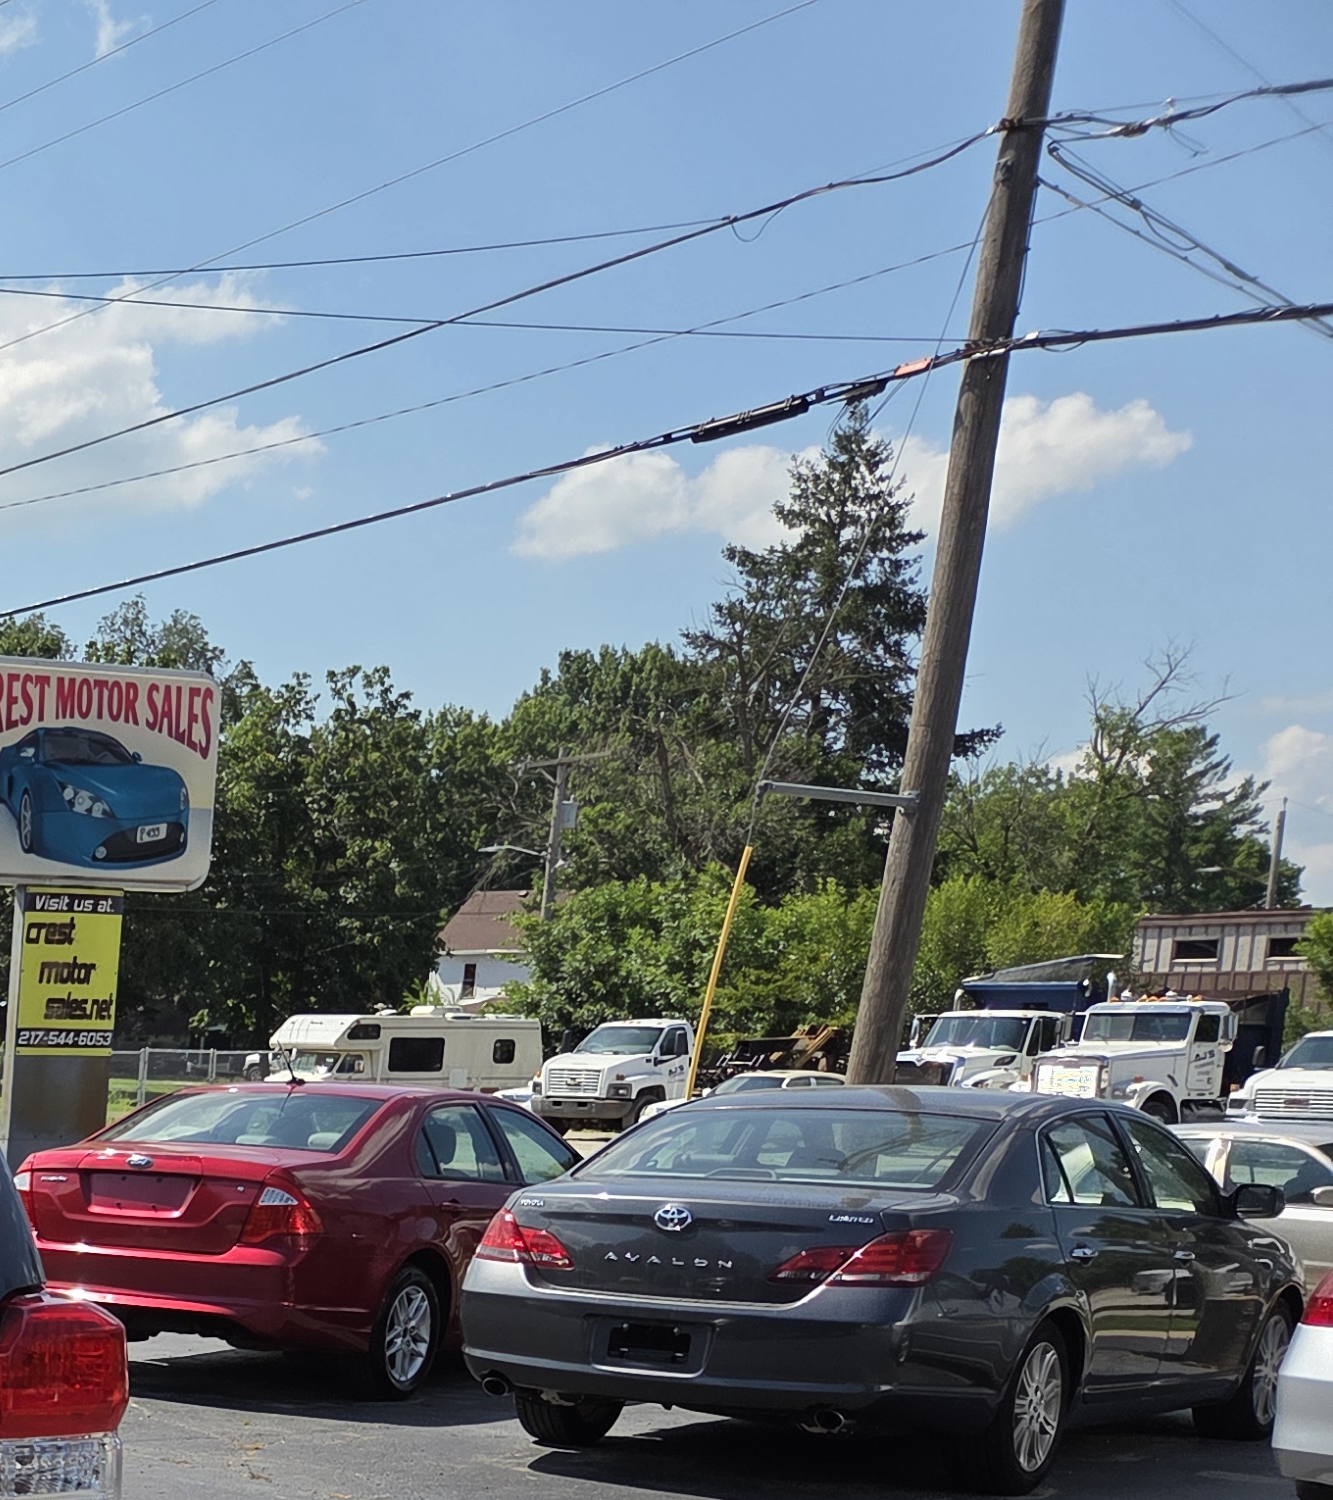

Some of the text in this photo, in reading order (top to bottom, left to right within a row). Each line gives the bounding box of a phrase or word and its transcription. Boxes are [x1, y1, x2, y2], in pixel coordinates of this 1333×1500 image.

[55, 675, 140, 727] MOTOR
[145, 682, 214, 760] SALES
[35, 895, 70, 911] Visit
[73, 899, 94, 912] us
[25, 916, 76, 945] crest
[38, 955, 97, 985] motor
[44, 991, 114, 1021] sales.net
[17, 1031, 113, 1046] 217-544-6053
[604, 1251, 733, 1269] AVALON
